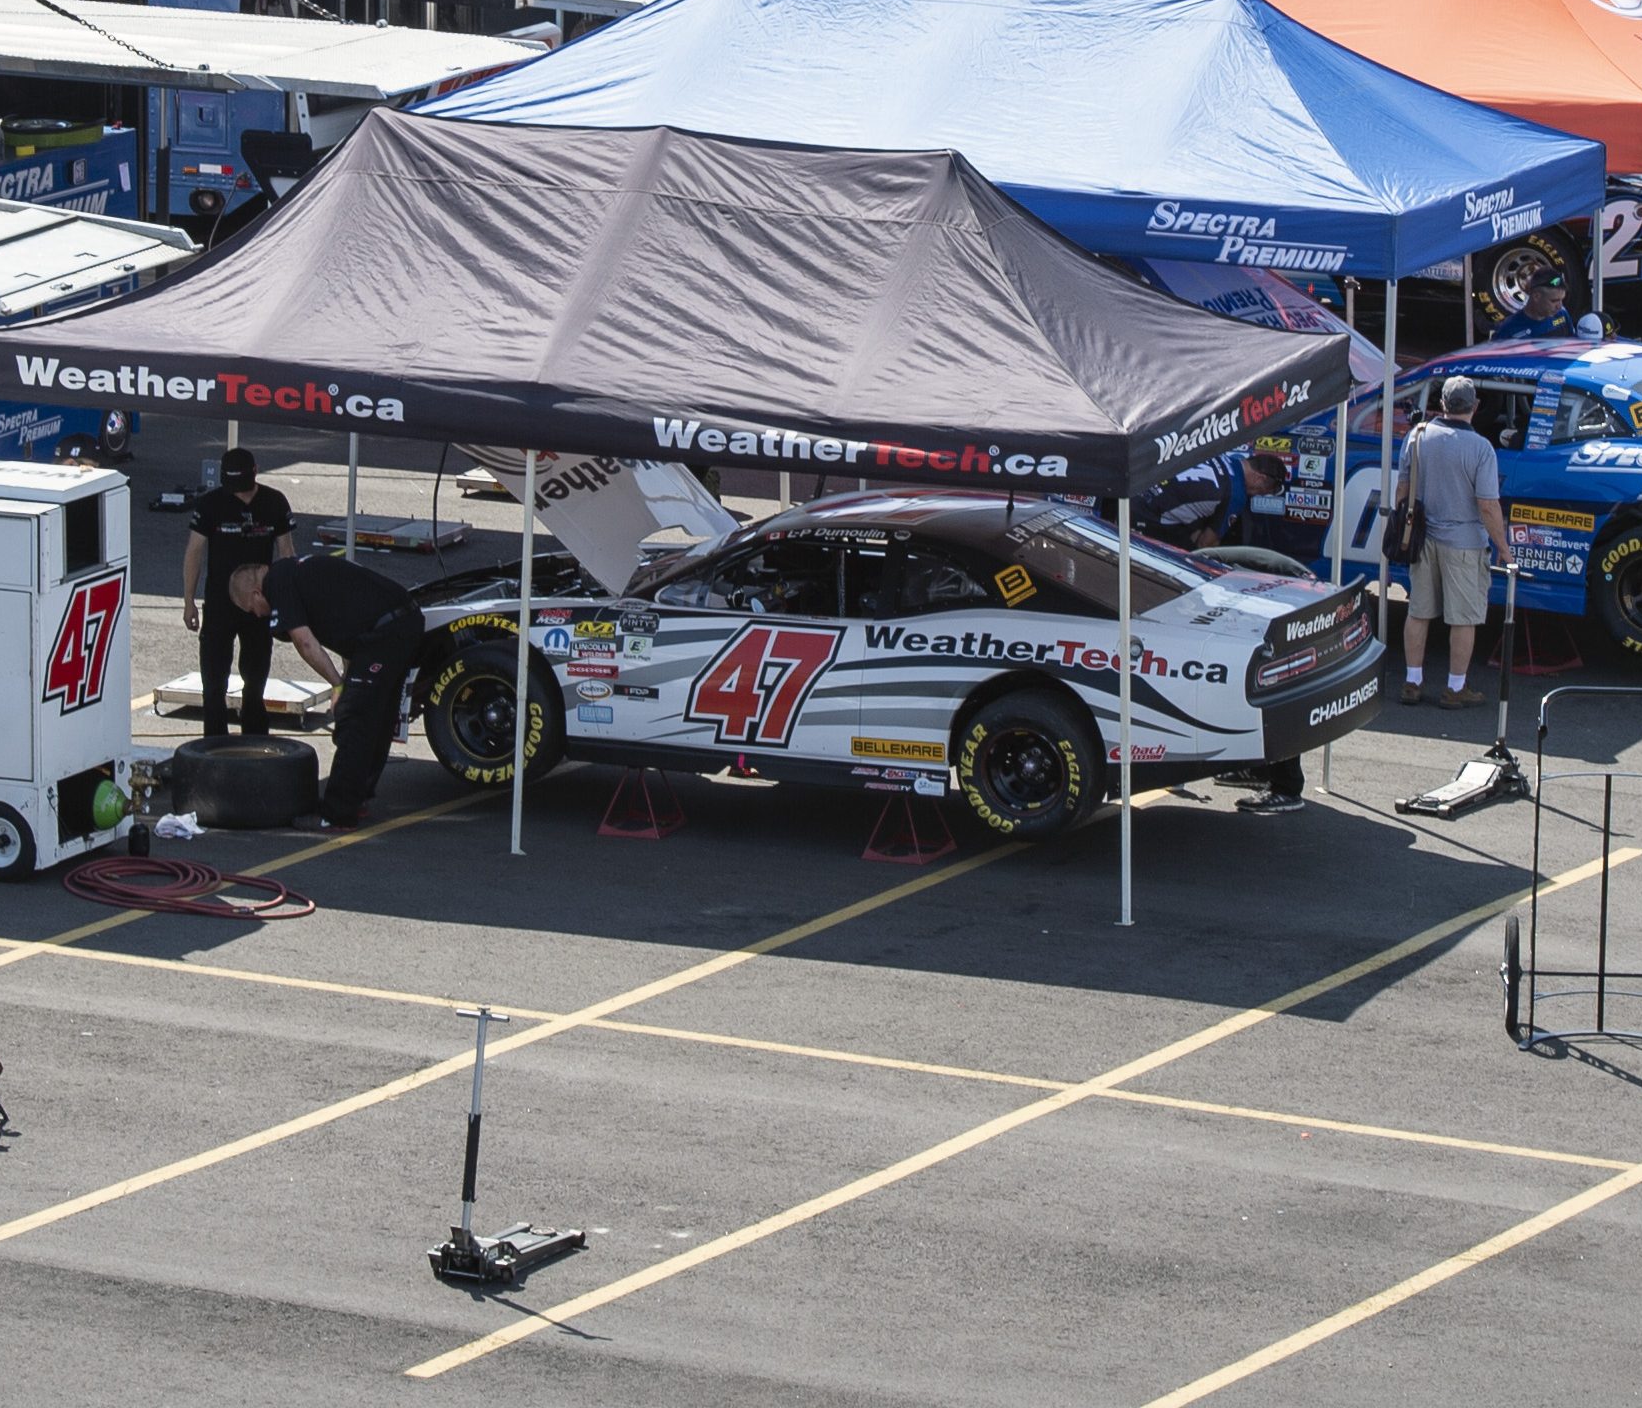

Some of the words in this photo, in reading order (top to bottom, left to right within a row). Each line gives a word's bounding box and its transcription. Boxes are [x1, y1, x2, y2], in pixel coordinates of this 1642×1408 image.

[1464, 188, 1515, 223] SPECTRA
[1147, 200, 1276, 238] SPECTRA
[1527, 234, 1565, 266] EAGLE
[1474, 364, 1541, 378] Dumoulin
[1287, 493, 1317, 504] Mobil
[1287, 507, 1330, 520] TREND
[1513, 508, 1593, 527] BELLEMARE
[815, 528, 887, 541] Dumoulin
[1544, 535, 1590, 551] Boisvert
[622, 619, 656, 628] PINTY'S
[46, 572, 125, 713] 47
[574, 642, 609, 652] LINCOLN
[581, 650, 612, 659] WELDERS
[691, 624, 839, 741] 47
[1310, 678, 1379, 727] CHALLENGER
[853, 740, 944, 759] BELLEMARE
[1058, 739, 1081, 798] EAGLE
[960, 723, 1014, 834] GOODYEAR
